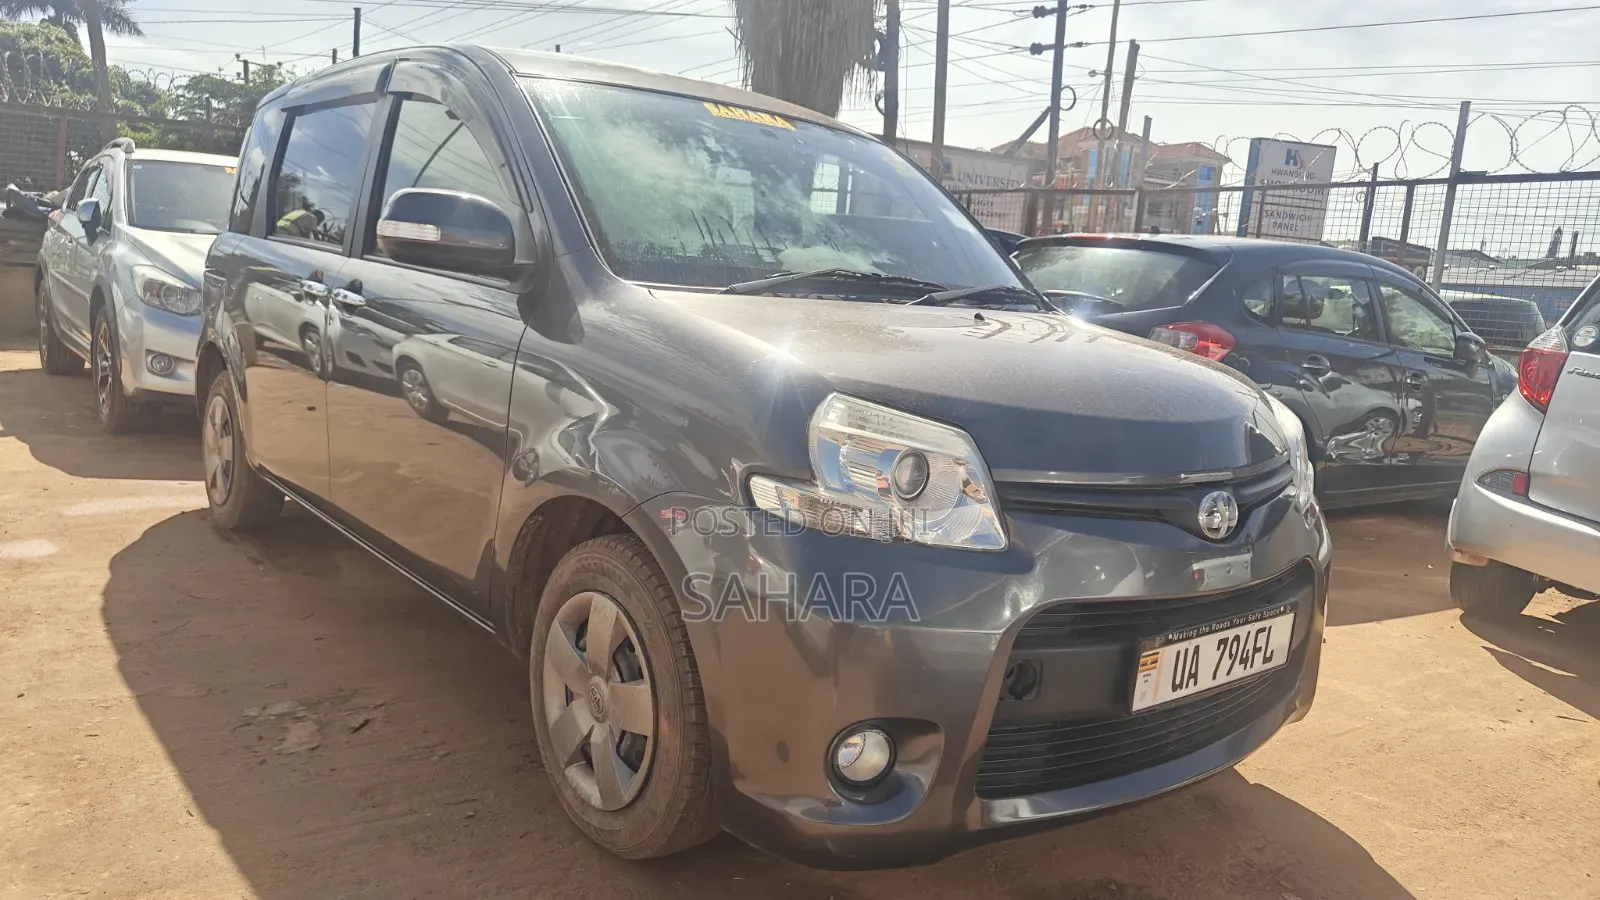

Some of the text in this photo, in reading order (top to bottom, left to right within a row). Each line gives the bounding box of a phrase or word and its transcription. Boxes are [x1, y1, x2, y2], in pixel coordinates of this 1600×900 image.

[957, 171, 1023, 191] UNIVERSITY
[1264, 210, 1311, 222] SANDWICH
[1272, 221, 1299, 232] PANEL
[1199, 625, 1210, 634] the
[1211, 621, 1231, 632] Roads
[1247, 613, 1262, 621] Safe
[1262, 609, 1280, 619] Space
[1171, 625, 1274, 693] UA 794FL
